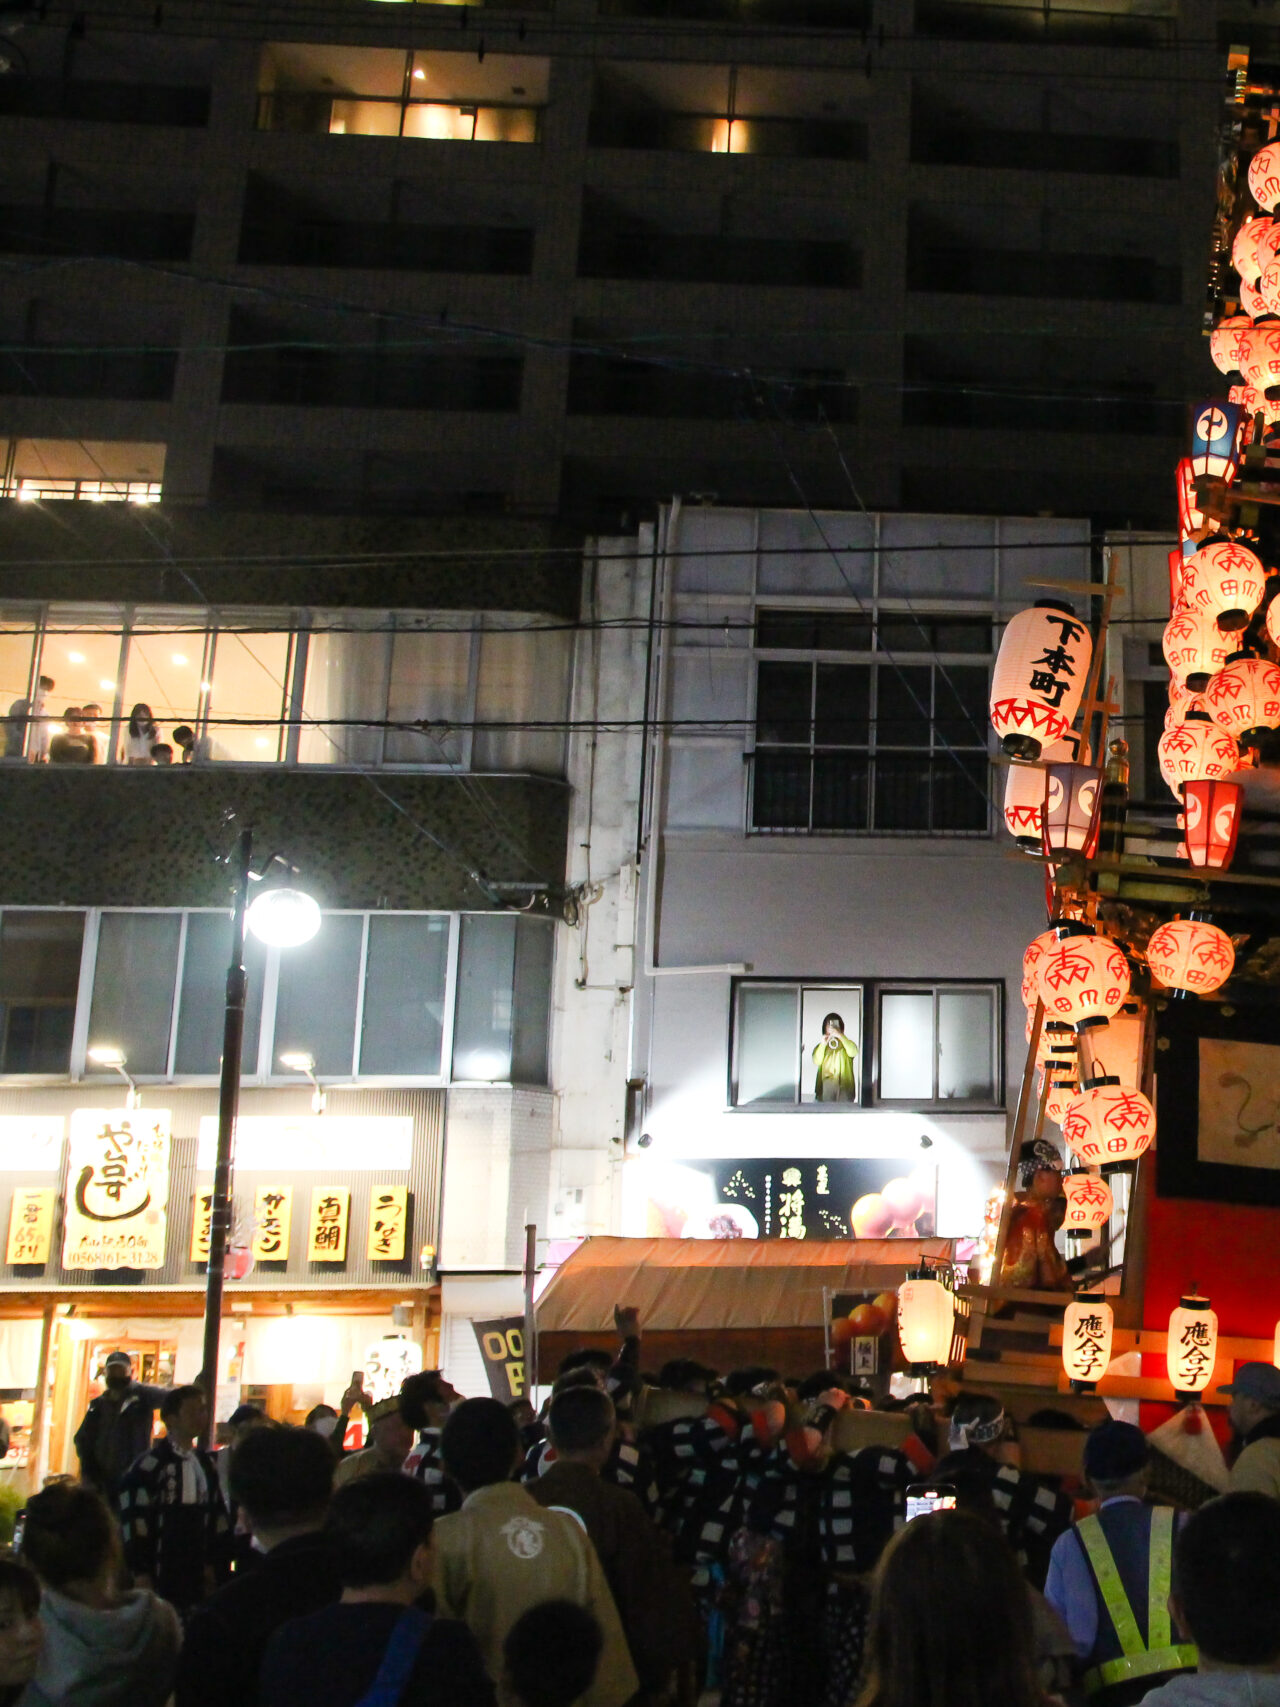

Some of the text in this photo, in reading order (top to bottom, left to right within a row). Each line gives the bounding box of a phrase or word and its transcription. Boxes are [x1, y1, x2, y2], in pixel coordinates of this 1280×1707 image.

[1029, 614, 1085, 708] 下本町
[314, 1197, 342, 1250] 真鯛
[374, 1195, 402, 1253] うなぎ
[68, 1251, 158, 1265] (0568)61-3128
[1073, 1314, 1107, 1378] 應合子
[1179, 1321, 1213, 1387] 應合子
